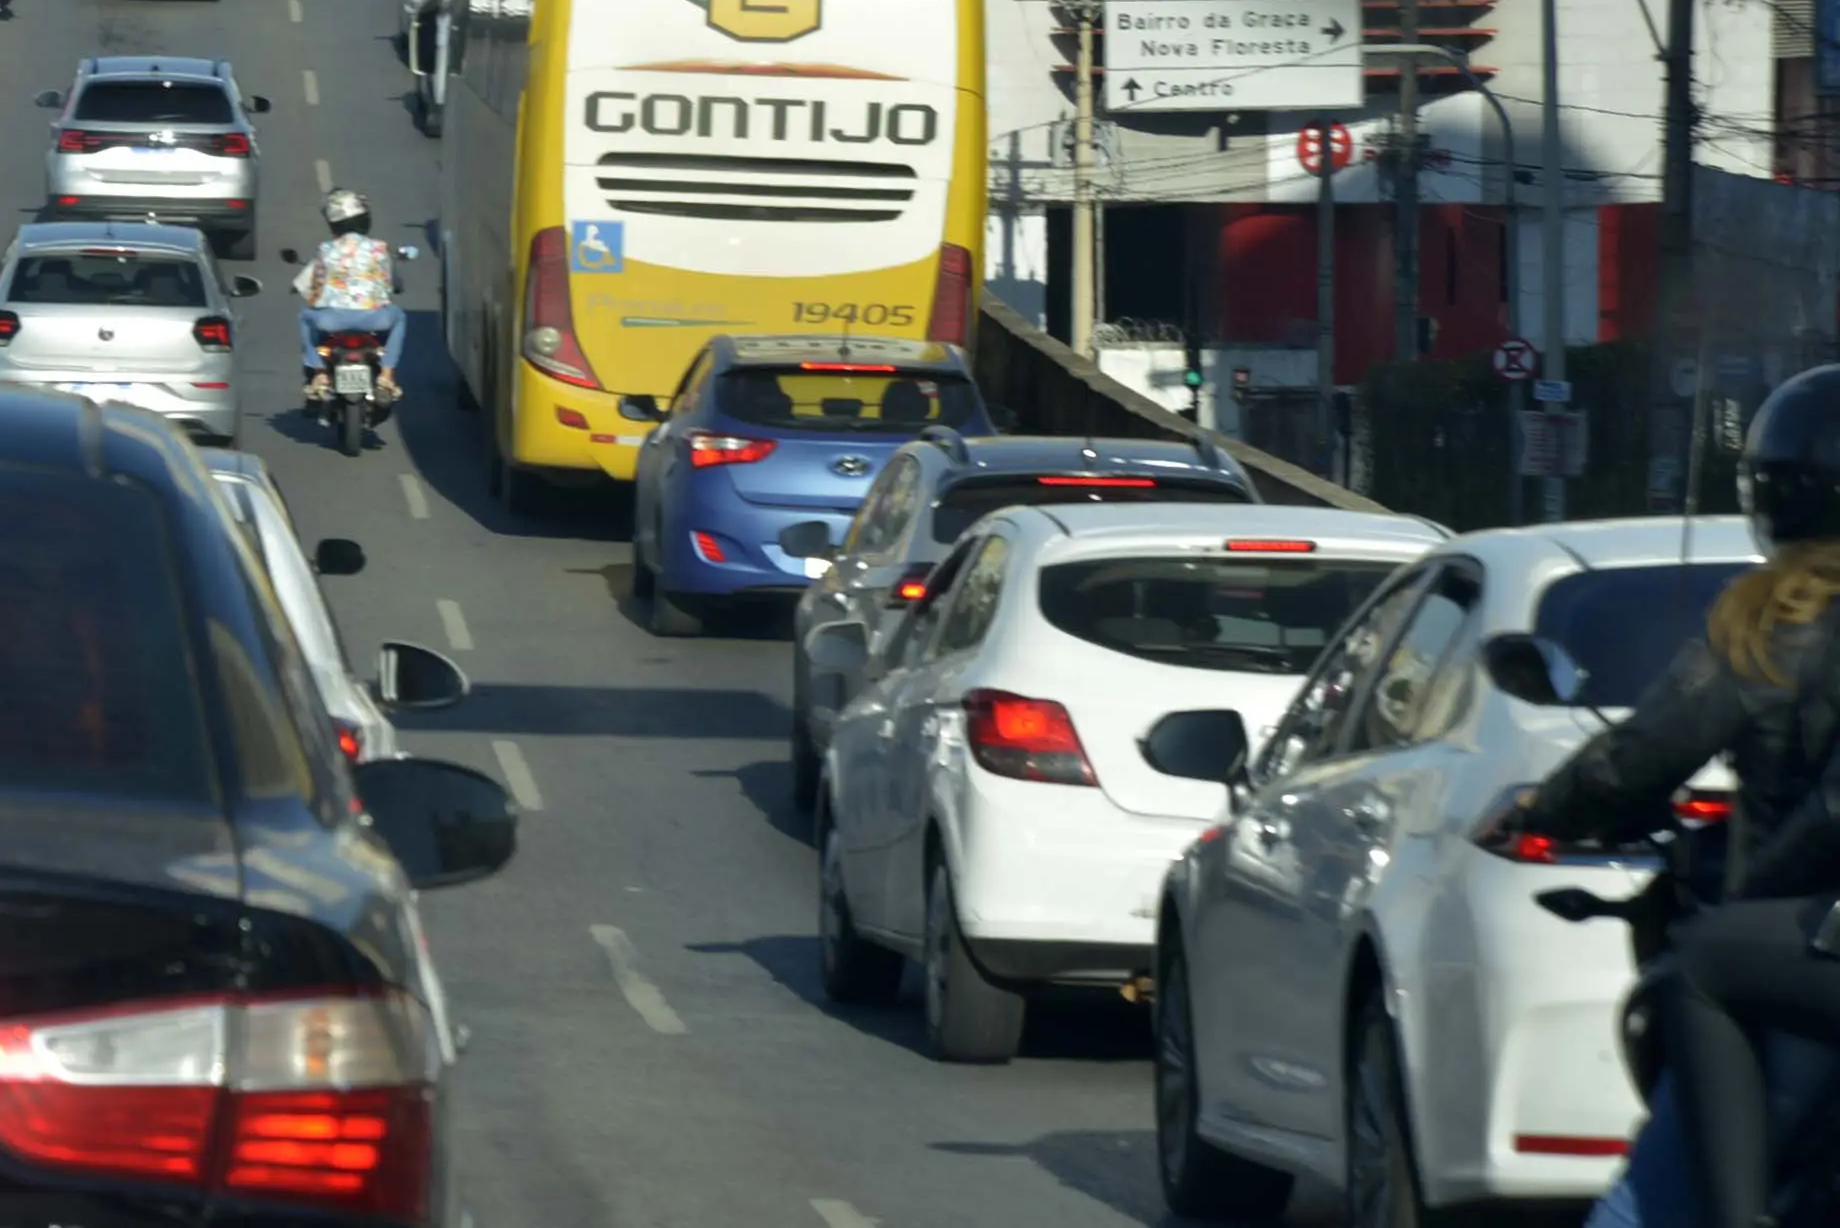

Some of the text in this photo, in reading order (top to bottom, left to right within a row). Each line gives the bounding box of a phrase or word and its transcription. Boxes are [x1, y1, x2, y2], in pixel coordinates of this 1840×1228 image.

[1117, 13, 1191, 31] Bairro
[1203, 13, 1231, 29] da
[1140, 38, 1311, 57] Nova Floresta
[1154, 80, 1235, 97] Centro
[584, 90, 938, 146] GONTIJO
[792, 302, 916, 326] 19405
